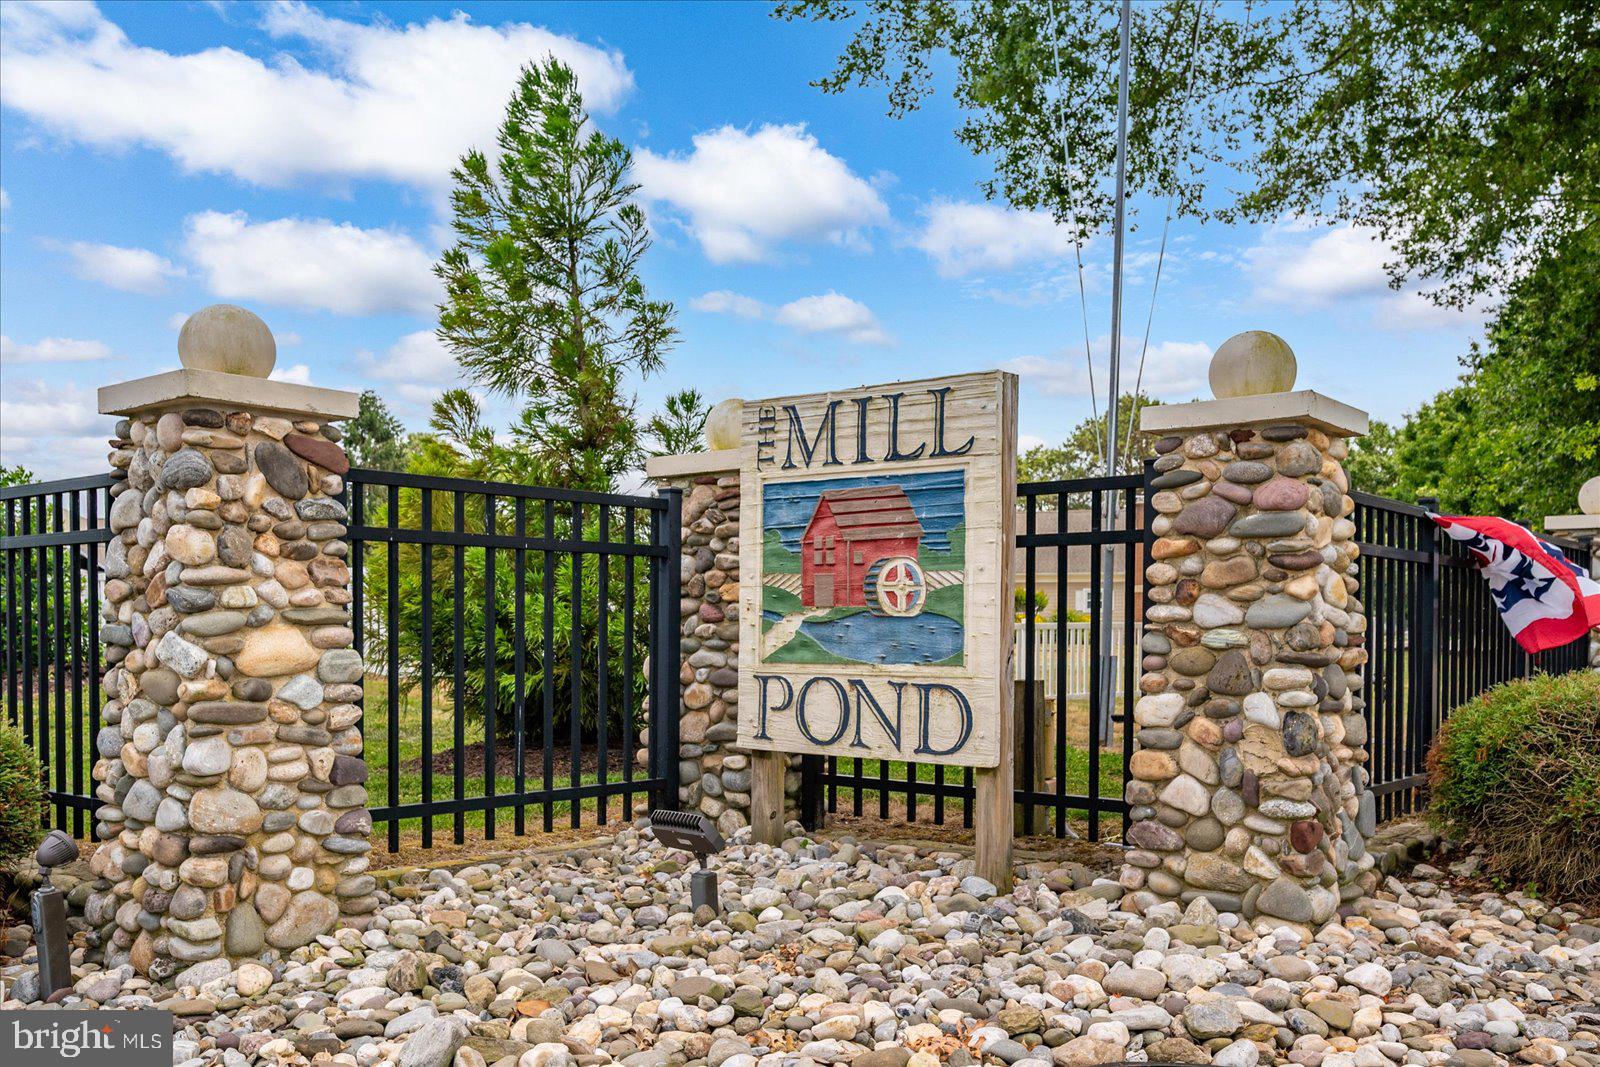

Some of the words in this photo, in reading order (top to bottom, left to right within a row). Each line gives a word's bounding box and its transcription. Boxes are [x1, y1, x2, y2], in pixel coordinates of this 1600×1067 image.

[757, 405, 777, 472] THE
[781, 386, 975, 470] MILL
[753, 675, 973, 755] POND
